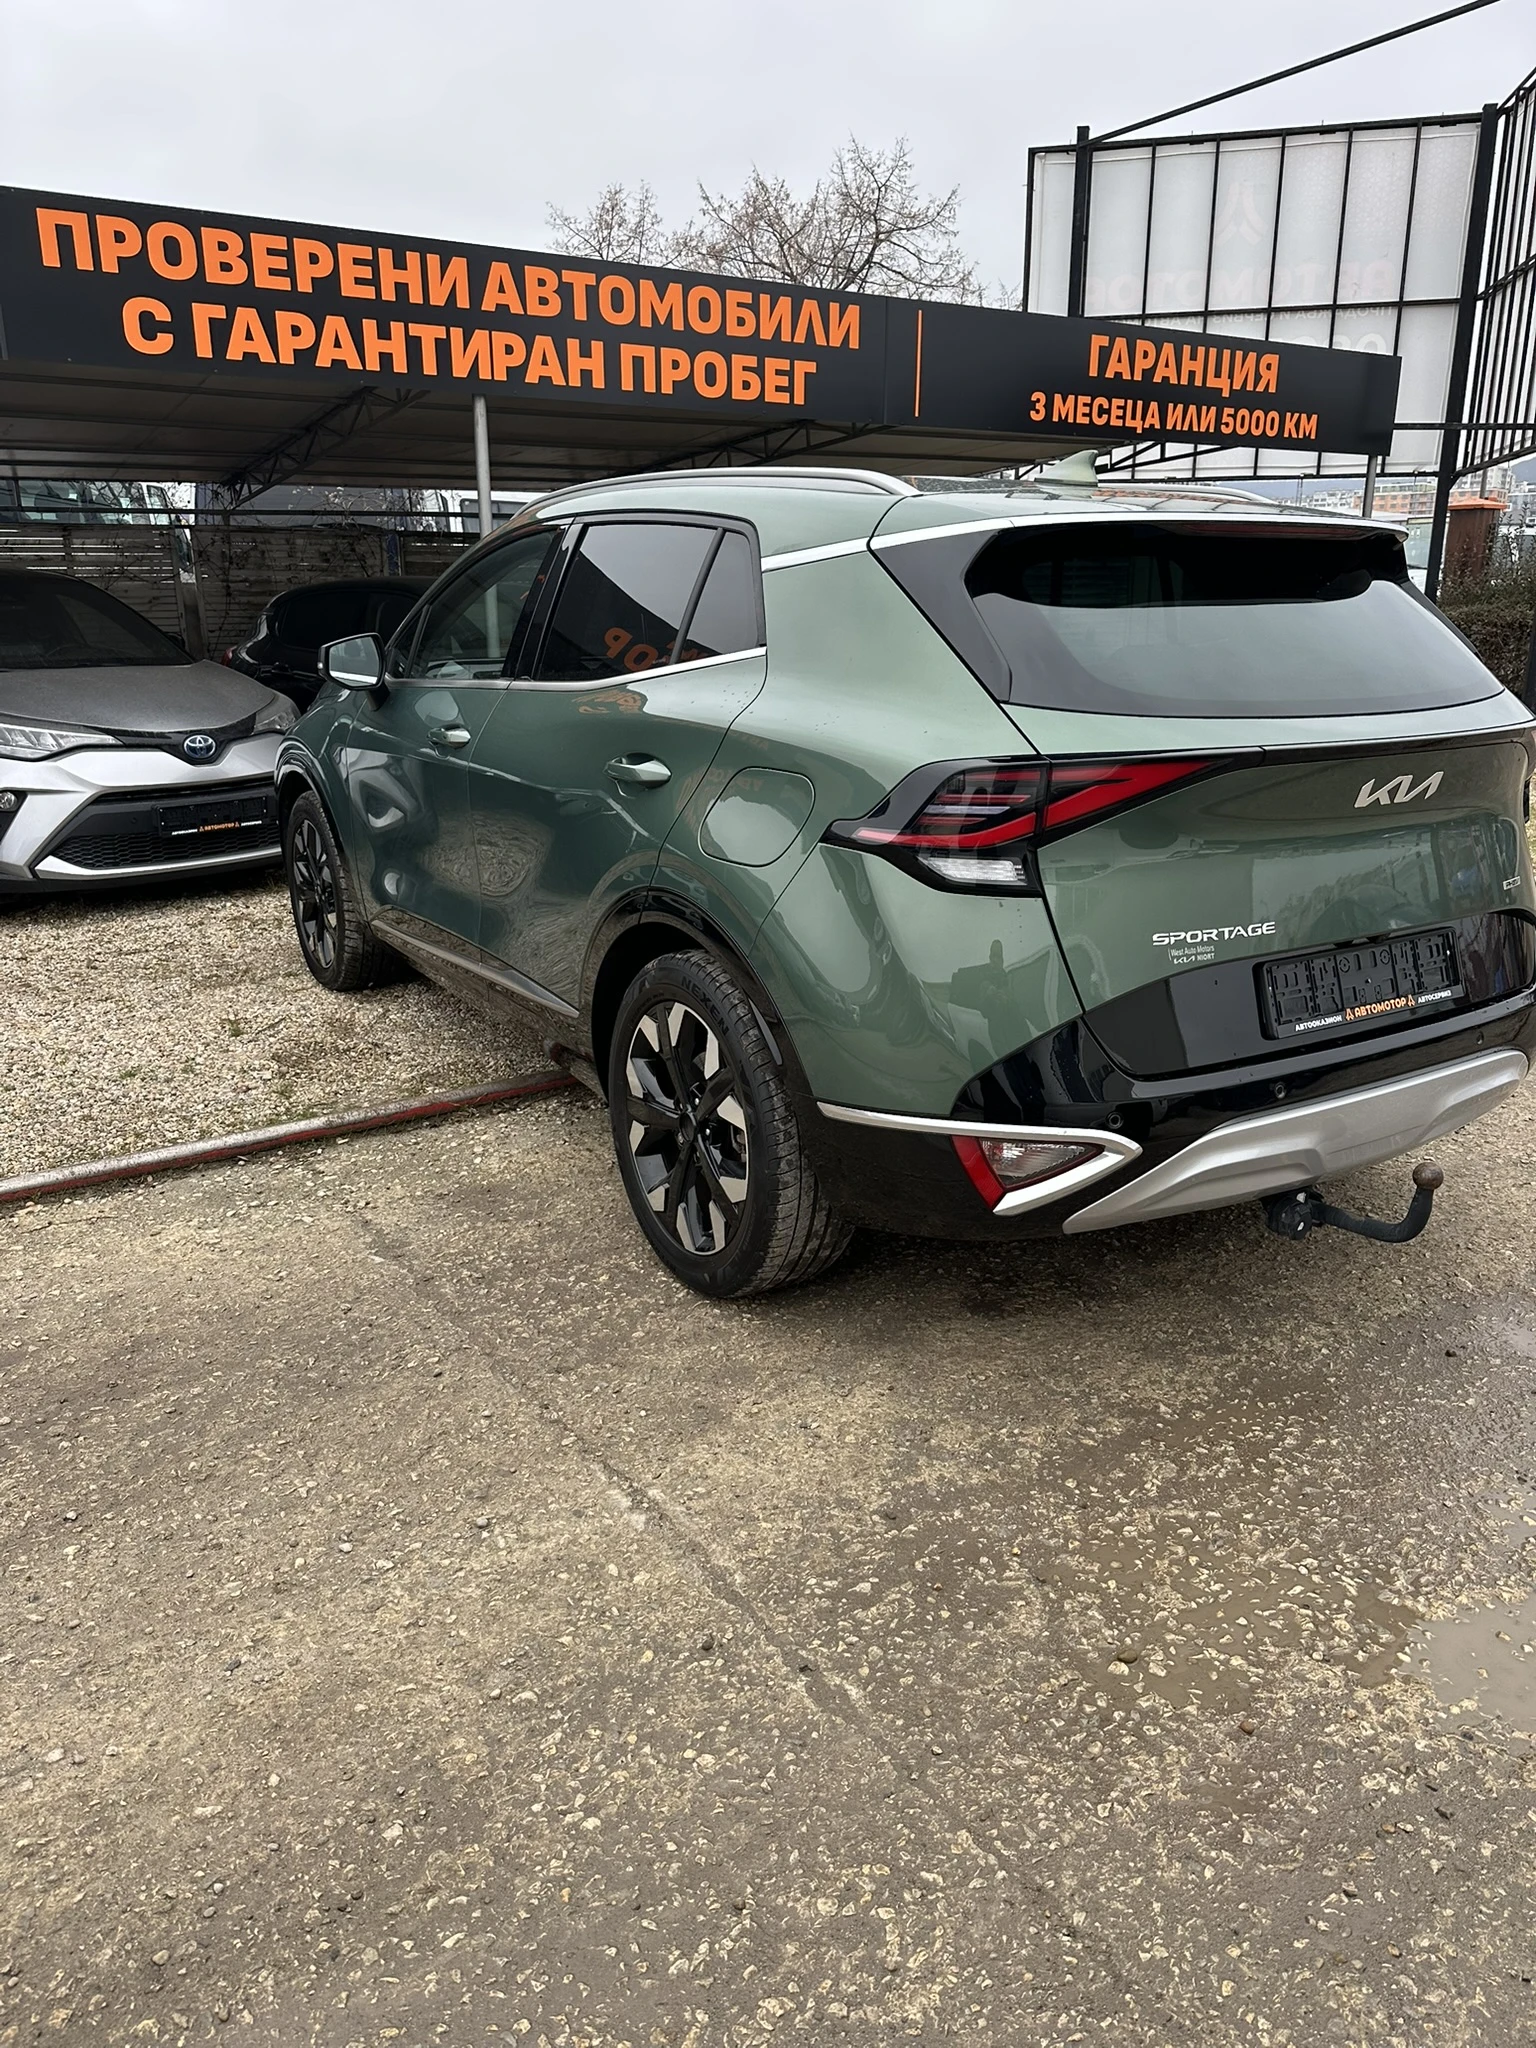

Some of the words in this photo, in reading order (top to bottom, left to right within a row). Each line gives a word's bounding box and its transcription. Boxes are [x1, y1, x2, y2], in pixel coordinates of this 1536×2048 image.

[37, 207, 470, 310] ПРОВЕРЕНИ
[481, 260, 861, 350] АВТОМОБИЛИ
[122, 296, 174, 356] С
[191, 302, 605, 390] ГАРАНТИРАН
[620, 343, 817, 406] ПРОБЕГ
[1088, 334, 1280, 397] ГАРАНЦИЯ
[1030, 391, 1046, 422] 3
[1052, 394, 1160, 433] МЕСЕЦА
[1166, 404, 1216, 432] ИЛИ
[1221, 407, 1280, 438] 5000
[1284, 413, 1318, 439] КМ
[1353, 771, 1444, 809] KIA
[1152, 921, 1276, 946] SPORTAGE
[681, 976, 730, 1036] NEXEN
[1355, 996, 1407, 1018] АВТОМОТОР
